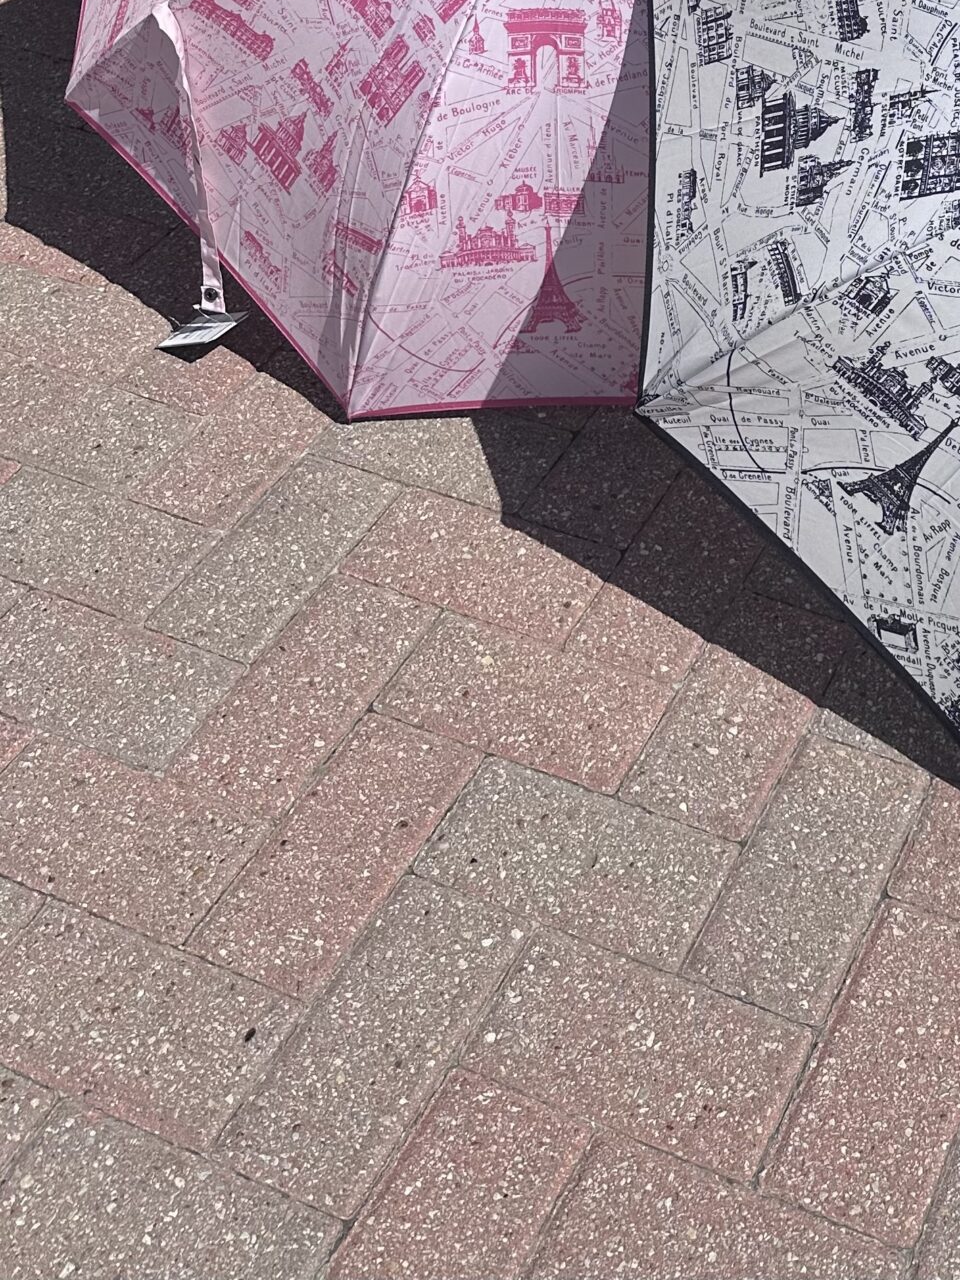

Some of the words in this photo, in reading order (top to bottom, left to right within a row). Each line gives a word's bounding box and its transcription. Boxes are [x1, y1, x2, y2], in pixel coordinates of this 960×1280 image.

[749, 19, 786, 37] Boulevard
[797, 33, 820, 48] Saint
[835, 45, 864, 60] Michel
[895, 344, 936, 360] Avenue
[843, 525, 854, 564] Avenue
[872, 543, 898, 573] Champ
